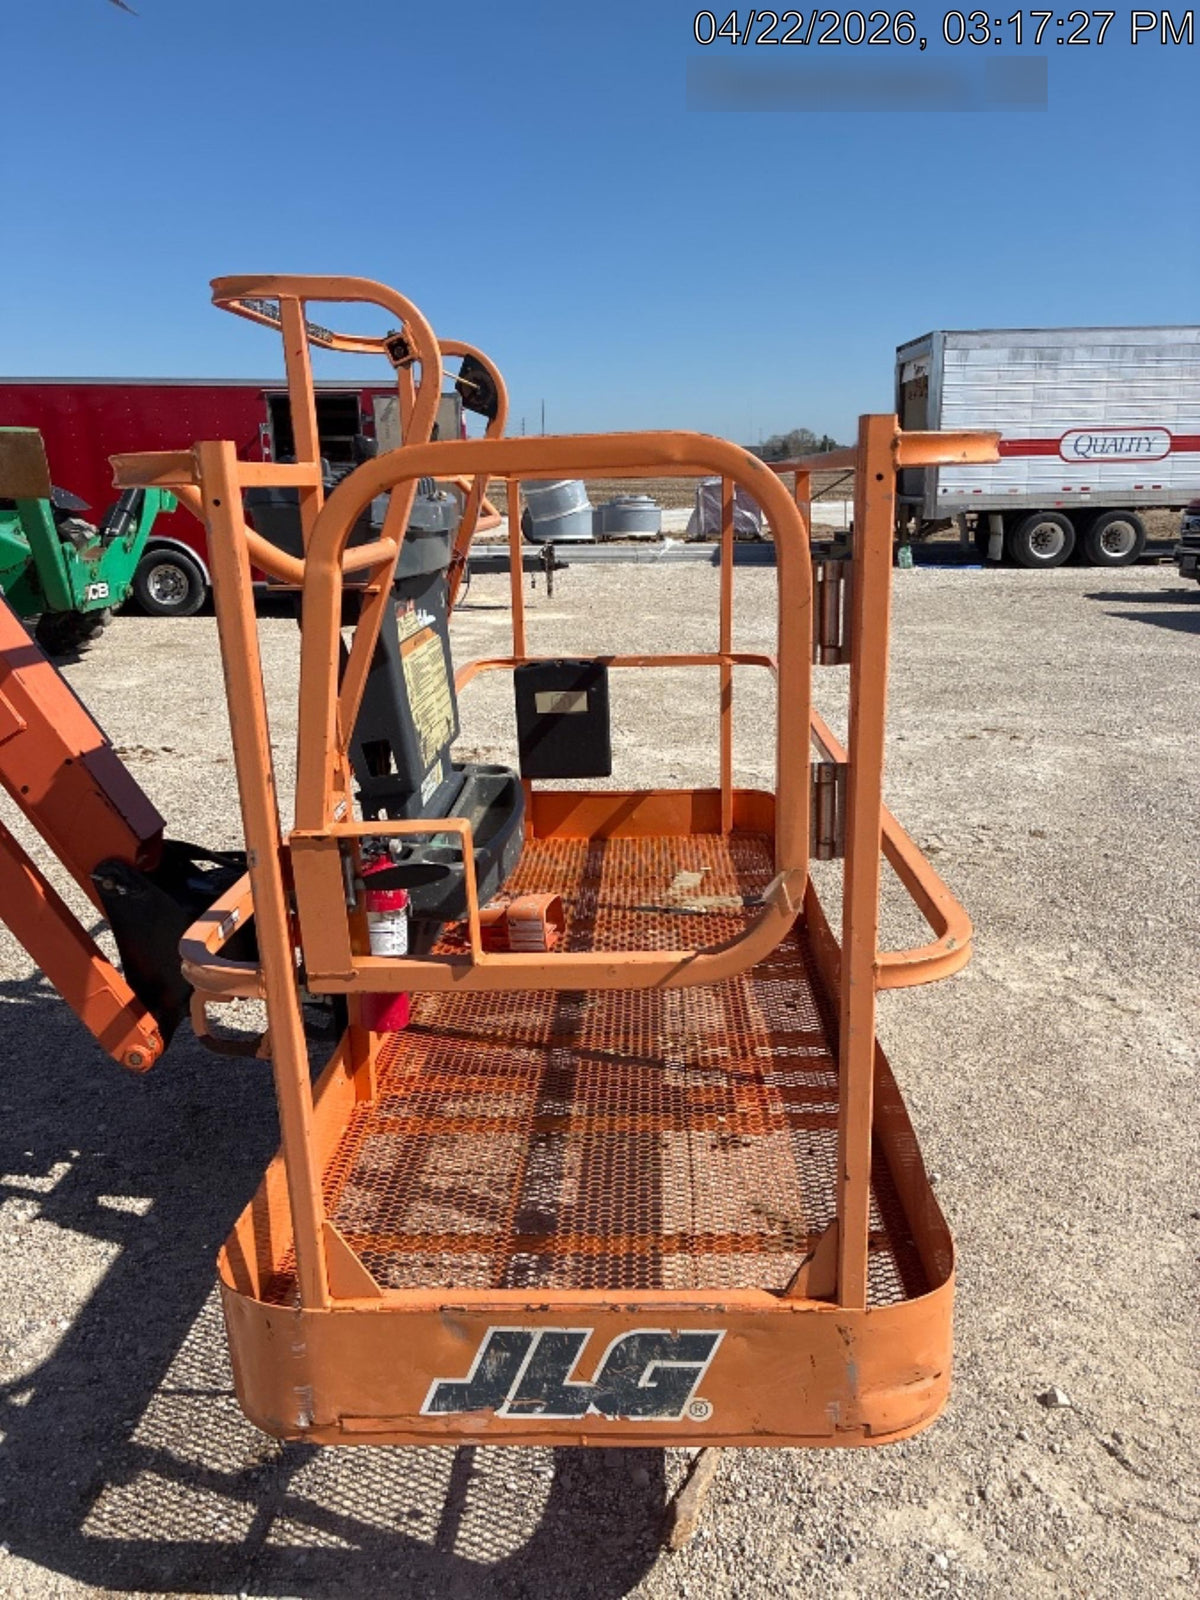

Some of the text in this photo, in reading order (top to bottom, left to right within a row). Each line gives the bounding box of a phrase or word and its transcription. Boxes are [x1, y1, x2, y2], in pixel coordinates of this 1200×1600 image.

[1074, 434, 1158, 458] QUALITY
[85, 582, 109, 600] CB
[420, 1326, 727, 1421] JLG
